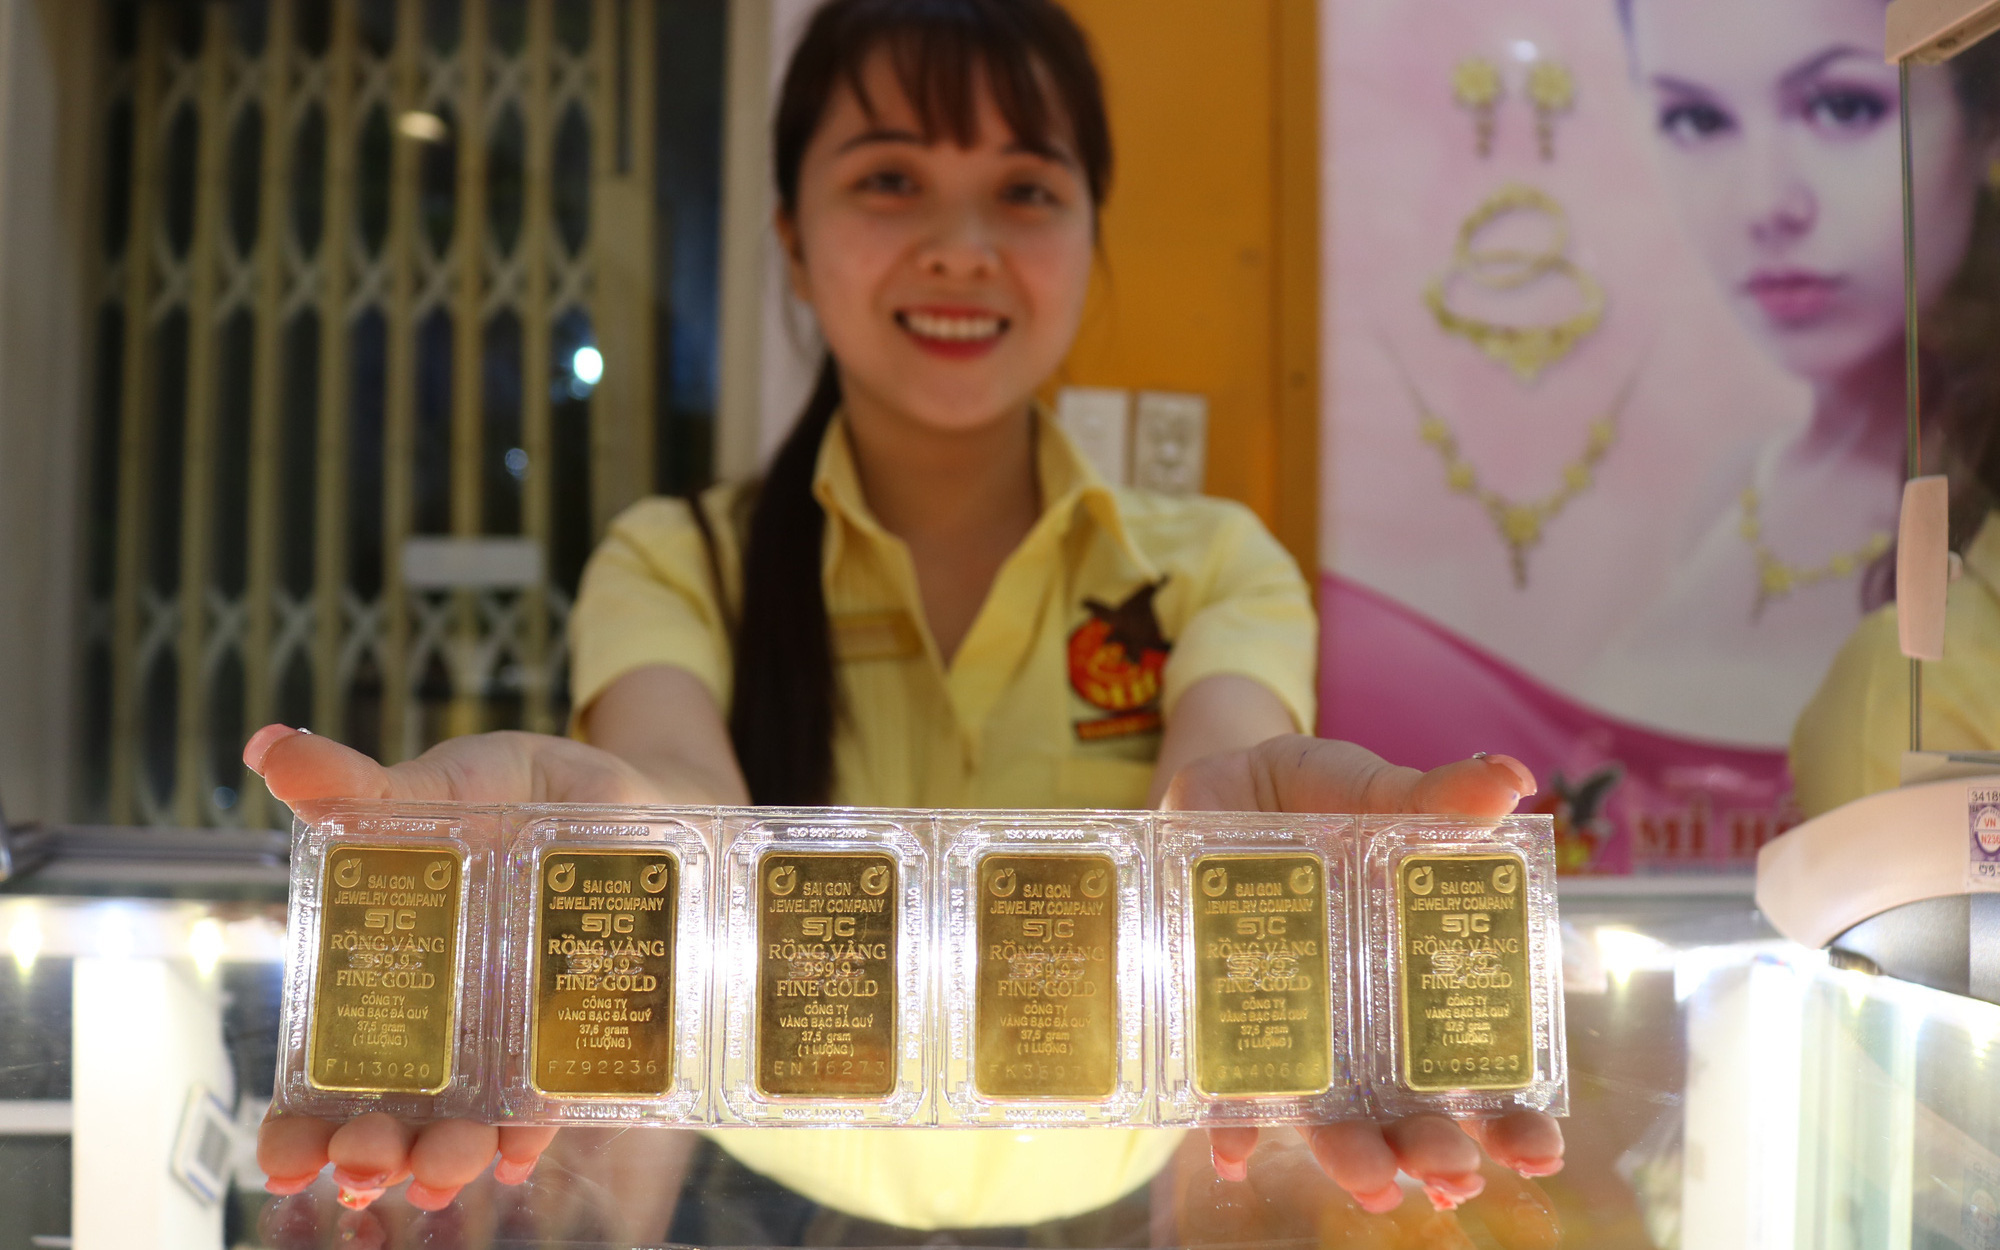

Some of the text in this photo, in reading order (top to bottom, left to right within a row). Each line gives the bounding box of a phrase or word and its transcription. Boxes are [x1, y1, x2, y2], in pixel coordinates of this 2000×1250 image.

[1984, 818, 1996, 827] VN
[368, 875, 414, 889] SAI GON
[583, 880, 631, 893] SAI GON
[803, 883, 851, 895] SAI GON
[1441, 881, 1484, 894] SAI GON
[1023, 884, 1071, 898] SAI GON
[335, 891, 446, 907] JEWELRY COMPANY
[549, 897, 664, 910] JEWELRY COMPANY
[770, 900, 884, 912] JEWELRY COMPANY
[1411, 897, 1514, 911] JEWELRY COMPANY
[990, 901, 1103, 915] JEWELRY COMPANY
[365, 909, 416, 934] SJC
[582, 914, 634, 938] SJC
[802, 917, 855, 941] SJC
[1023, 919, 1074, 942] SJC
[336, 970, 435, 988] FINE GOLD
[556, 975, 656, 991] FINE GOLD
[1422, 972, 1512, 989] FINE GOLD
[777, 980, 878, 996] FINE GOLD
[998, 980, 1096, 997] FINE GOLD
[362, 991, 405, 1005] CÔNG TY
[582, 996, 627, 1009] CÔNG TY
[338, 1004, 364, 1017] VÀNG
[558, 1008, 586, 1020] VÀNG
[804, 1001, 849, 1014] CÔNG TY
[1024, 1000, 1068, 1014] CÔNG TY
[780, 1015, 808, 1027] VÀNG
[382, 1024, 405, 1033] gram
[604, 1026, 628, 1036] gram
[826, 1033, 851, 1043] gram
[1045, 1032, 1069, 1042] gram
[549, 1060, 656, 1074] FZ92236
[774, 1061, 885, 1075] EN16273
